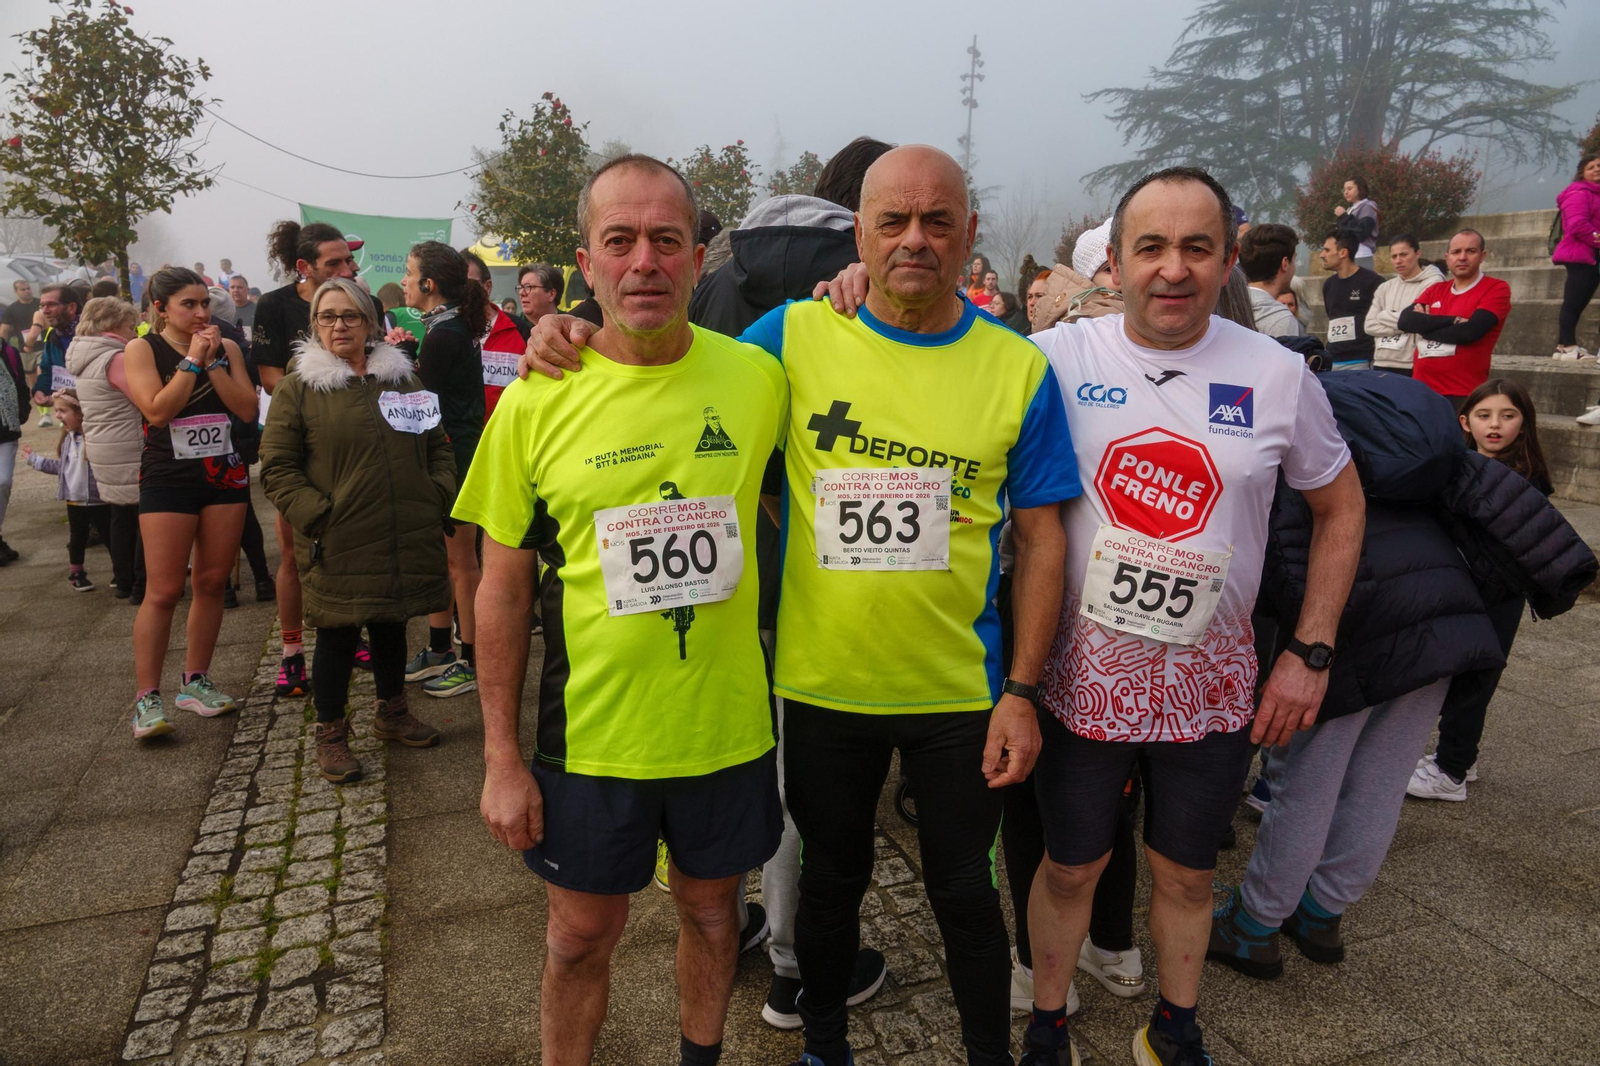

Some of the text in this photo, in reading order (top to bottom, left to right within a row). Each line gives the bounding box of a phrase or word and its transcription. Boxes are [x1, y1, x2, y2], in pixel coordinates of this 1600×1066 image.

[1332, 324, 1348, 336] 522
[483, 364, 519, 377] NDAINA
[388, 406, 439, 421] ANDAINA
[1209, 405, 1246, 423] AXA
[187, 427, 222, 446] 202
[1209, 425, 1254, 439] fundación
[595, 451, 618, 462] RUTA
[620, 443, 665, 456] MEMORIAL
[596, 460, 611, 469] BTT
[620, 451, 656, 464] ANDAINA
[849, 434, 981, 480] DEPORTE
[842, 473, 919, 481] CORREMOS
[1118, 452, 1206, 501] PONLE
[824, 482, 941, 491] CONTRA O CANCRO
[1111, 473, 1194, 520] FRENO
[628, 502, 706, 518] CORREMOS
[607, 510, 727, 532] CONTRA O CANCRO
[839, 500, 921, 544] 563
[626, 530, 643, 538] MOS,
[664, 525, 696, 533] FEBREIRO
[629, 530, 717, 584] 560
[1104, 540, 1221, 574] CONTRA O CANCRO
[1128, 537, 1204, 562] CORREMOS
[1101, 556, 1115, 564] MOS
[1118, 554, 1134, 564] MOS,
[1153, 564, 1185, 576] FEBREIRO
[641, 579, 709, 593] LUIS ALONSO BASTOS
[1109, 562, 1199, 619] 555
[1103, 603, 1183, 628] SALVADOR DAVILA BUGARIN
